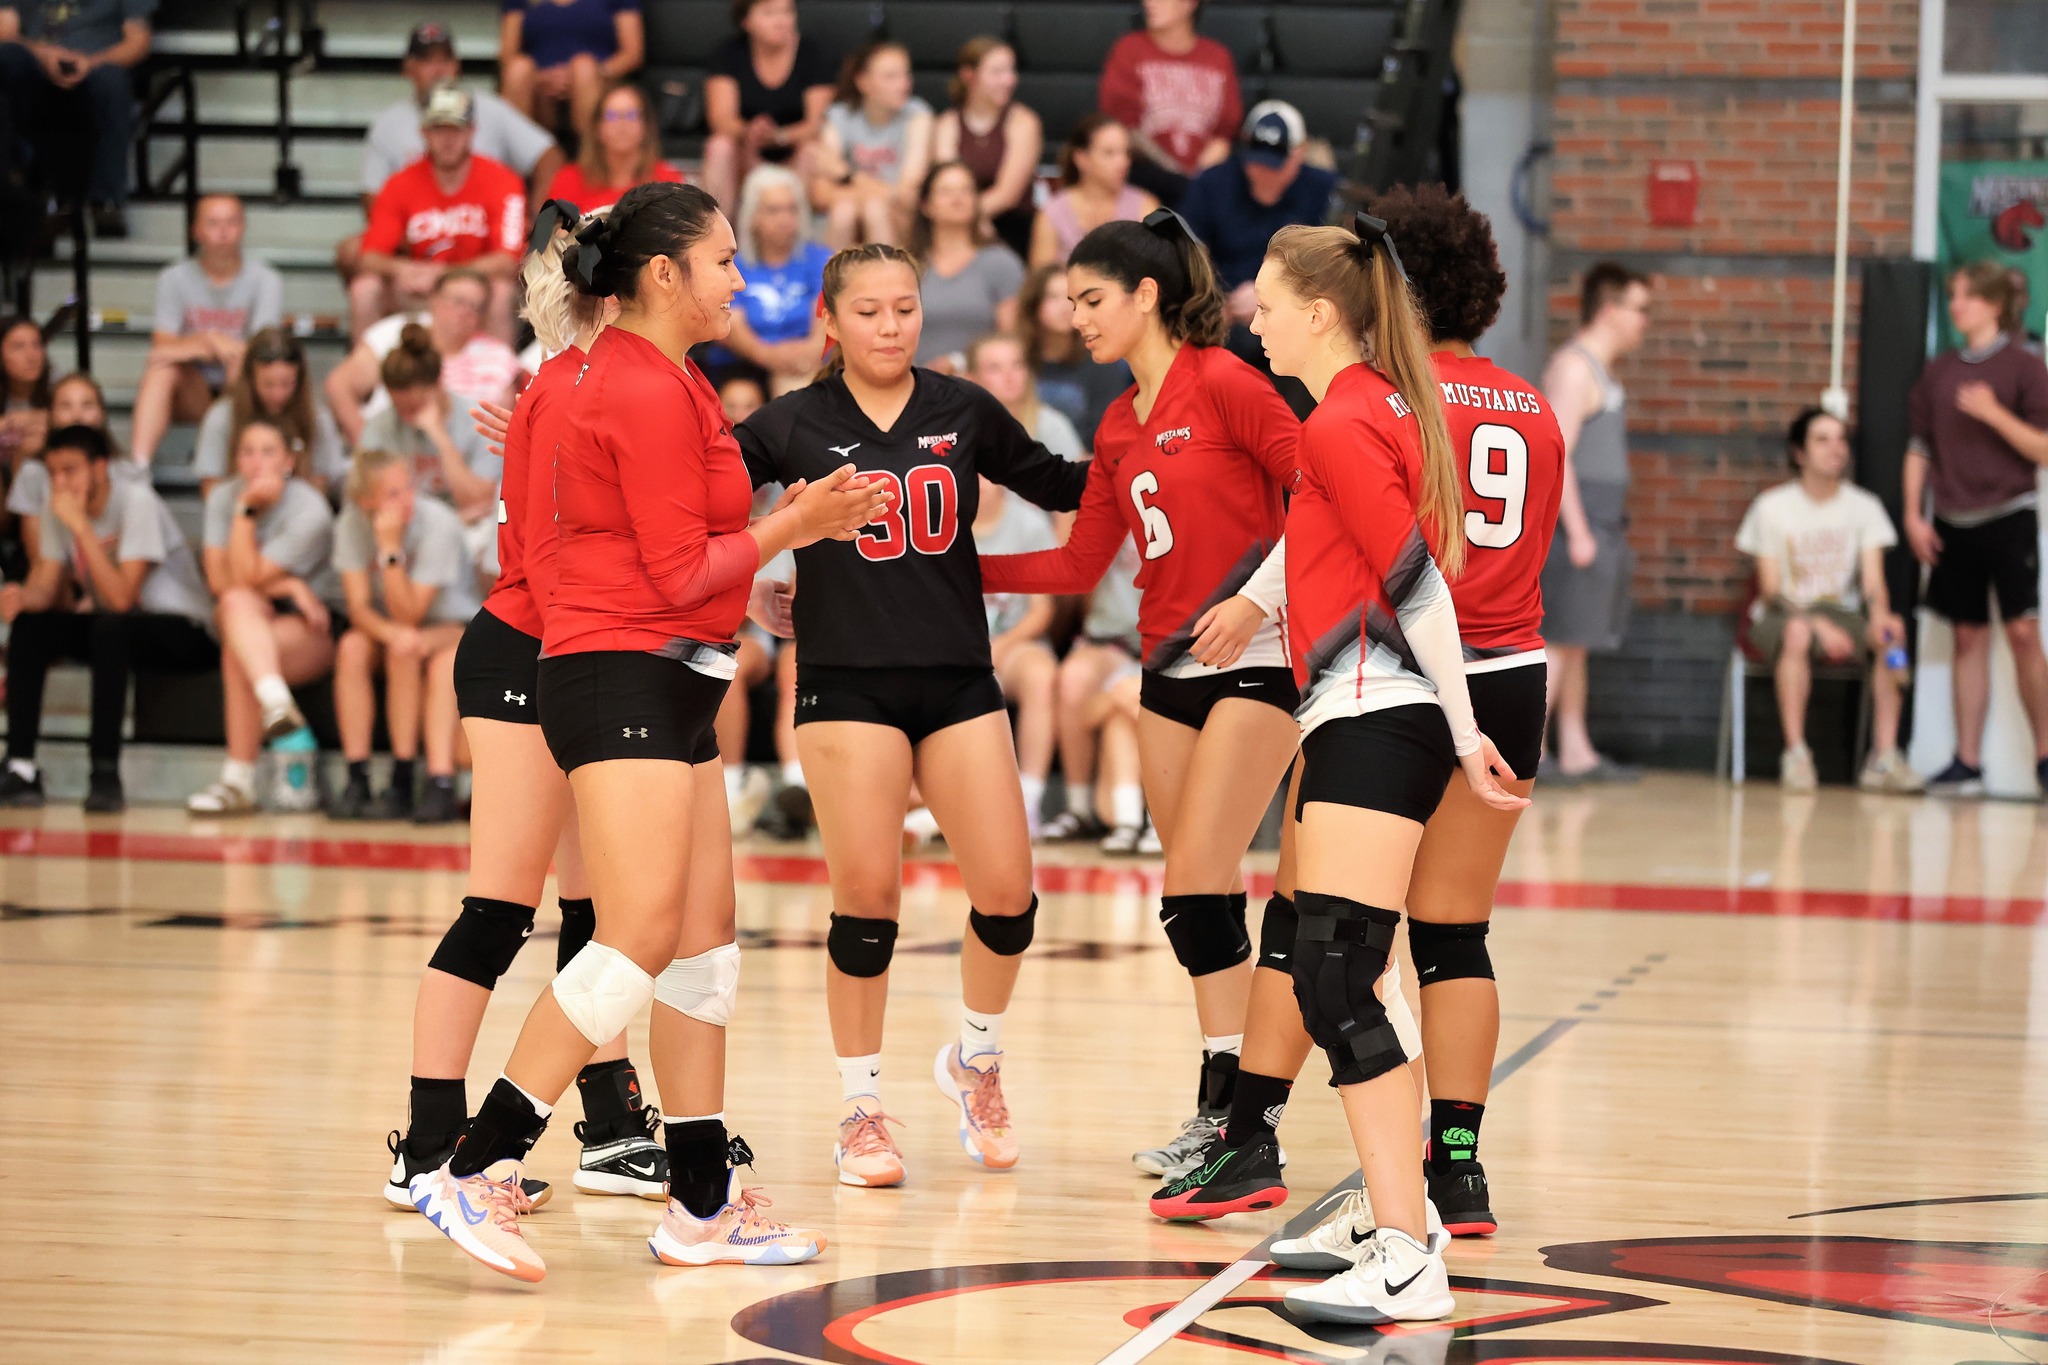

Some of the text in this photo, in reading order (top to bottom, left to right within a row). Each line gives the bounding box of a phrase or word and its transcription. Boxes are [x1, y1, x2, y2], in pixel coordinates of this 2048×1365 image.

[1439, 382, 1541, 414] MUSTANGS
[917, 432, 958, 449] MUSTANGS
[1154, 426, 1192, 447] MUSTANGS
[851, 464, 959, 562] 30
[1130, 469, 1175, 560] 6
[1464, 422, 1529, 549] 9
